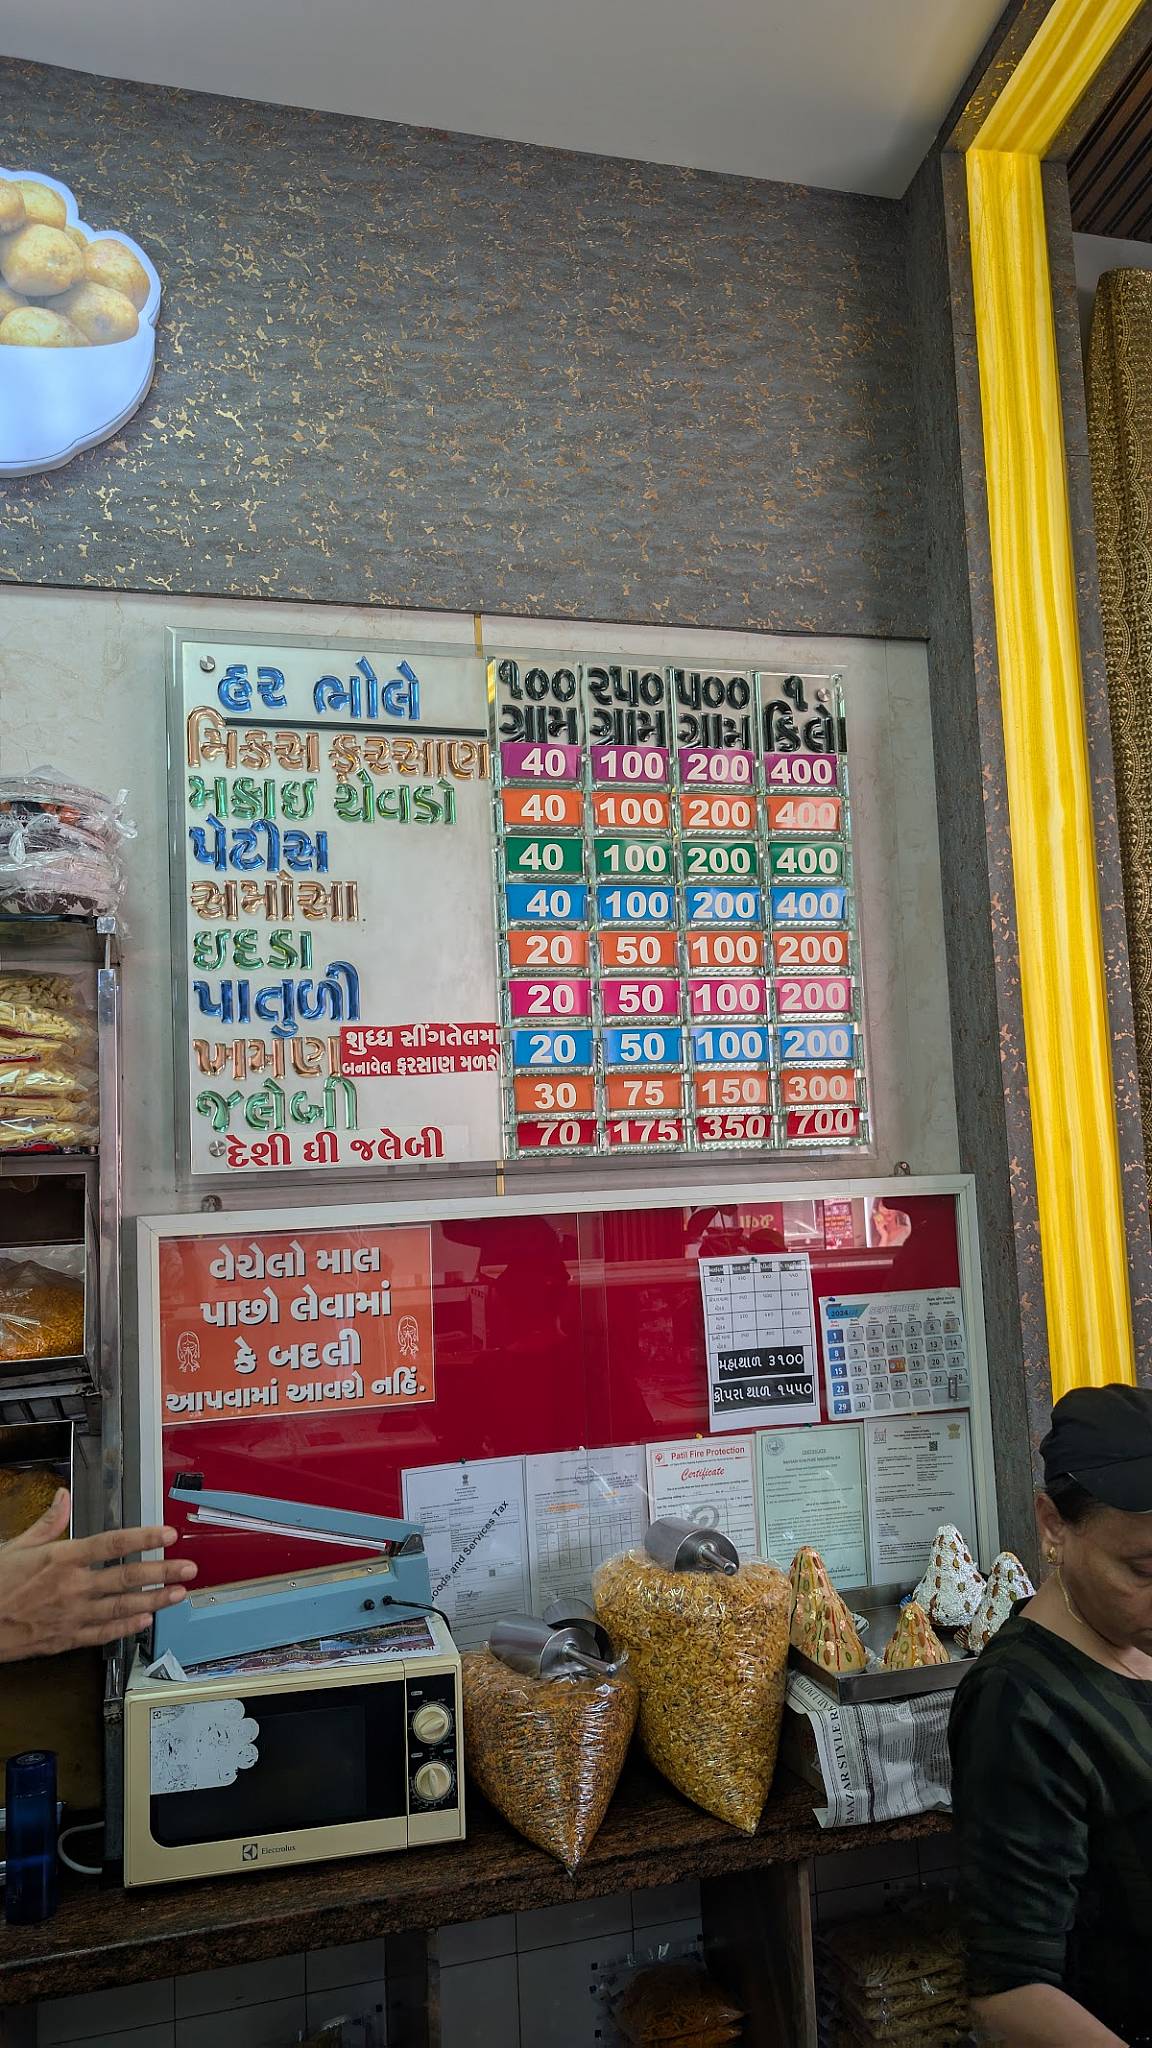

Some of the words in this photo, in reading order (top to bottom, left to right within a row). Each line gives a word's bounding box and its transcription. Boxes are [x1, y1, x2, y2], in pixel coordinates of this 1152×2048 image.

[217, 663, 287, 713] હર
[313, 656, 419, 720] ભોલે
[499, 704, 579, 744] ગ્રામ
[590, 708, 667, 747] ગ્રામ
[328, 734, 489, 784] ફરસાણ
[521, 748, 566, 777] 40
[601, 751, 663, 779] 100
[687, 754, 749, 781] 200
[771, 759, 832, 784] 400
[521, 794, 566, 822] 40
[600, 798, 663, 824] 100
[689, 800, 750, 827] 200
[775, 802, 836, 827] 400
[188, 812, 328, 872] પેટીસ
[518, 843, 564, 871] 40
[603, 845, 666, 872] 100
[688, 847, 750, 873] 200
[776, 848, 838, 874] 400
[190, 870, 359, 922] સમોસા
[526, 889, 571, 917] 40
[605, 890, 669, 918] 100
[693, 892, 755, 918] 200
[776, 892, 839, 918] 400
[525, 935, 572, 964] 20
[616, 936, 661, 964] 50
[692, 938, 758, 963] 100
[778, 936, 843, 963] 200
[528, 984, 574, 1013] 20
[618, 984, 664, 1012] 50
[695, 984, 759, 1011] 100
[780, 983, 845, 1010] 200
[192, 1036, 341, 1080] ખમણ
[342, 1056, 392, 1075] બનાવેલ
[397, 1055, 455, 1076] ફરસાણ
[529, 1034, 576, 1063] 20
[620, 1033, 665, 1061] 50
[697, 1031, 762, 1059] 100
[783, 1030, 849, 1057] 200
[195, 1076, 358, 1132] જલેબી
[534, 1083, 577, 1109] 30
[623, 1081, 664, 1106] 75
[701, 1078, 761, 1104] 150
[788, 1076, 848, 1101] 300
[536, 1121, 580, 1146] 70
[614, 1119, 678, 1144] 175
[703, 1114, 765, 1140] 350
[796, 1108, 853, 1135] 700
[226, 1132, 292, 1168] દેશી
[303, 1131, 341, 1163] ઘી
[350, 1126, 444, 1161] જલેબી
[209, 1240, 305, 1280] વેચેલો
[317, 1247, 380, 1274] માલ
[200, 1286, 279, 1326] પાછો
[290, 1279, 391, 1320] લેવામાં
[234, 1335, 257, 1374] કે
[268, 1328, 361, 1369] બદલી
[719, 1356, 762, 1372] મહાથાળ
[768, 1353, 804, 1366] ૩૧૦૦
[166, 1379, 279, 1412] આપવામાં
[286, 1371, 364, 1402] આવશે
[713, 1387, 744, 1403] કોપરા
[746, 1385, 771, 1398] થાળ
[777, 1382, 812, 1396] ૧૫૫૦
[689, 1450, 705, 1458] Fire
[706, 1446, 745, 1457] Protection
[680, 1466, 725, 1481] Certificate
[431, 1573, 451, 1601] oods
[450, 1554, 466, 1574] and
[463, 1517, 496, 1556] Services
[491, 1500, 509, 1517] Tax
[832, 1723, 848, 1769] STYLE
